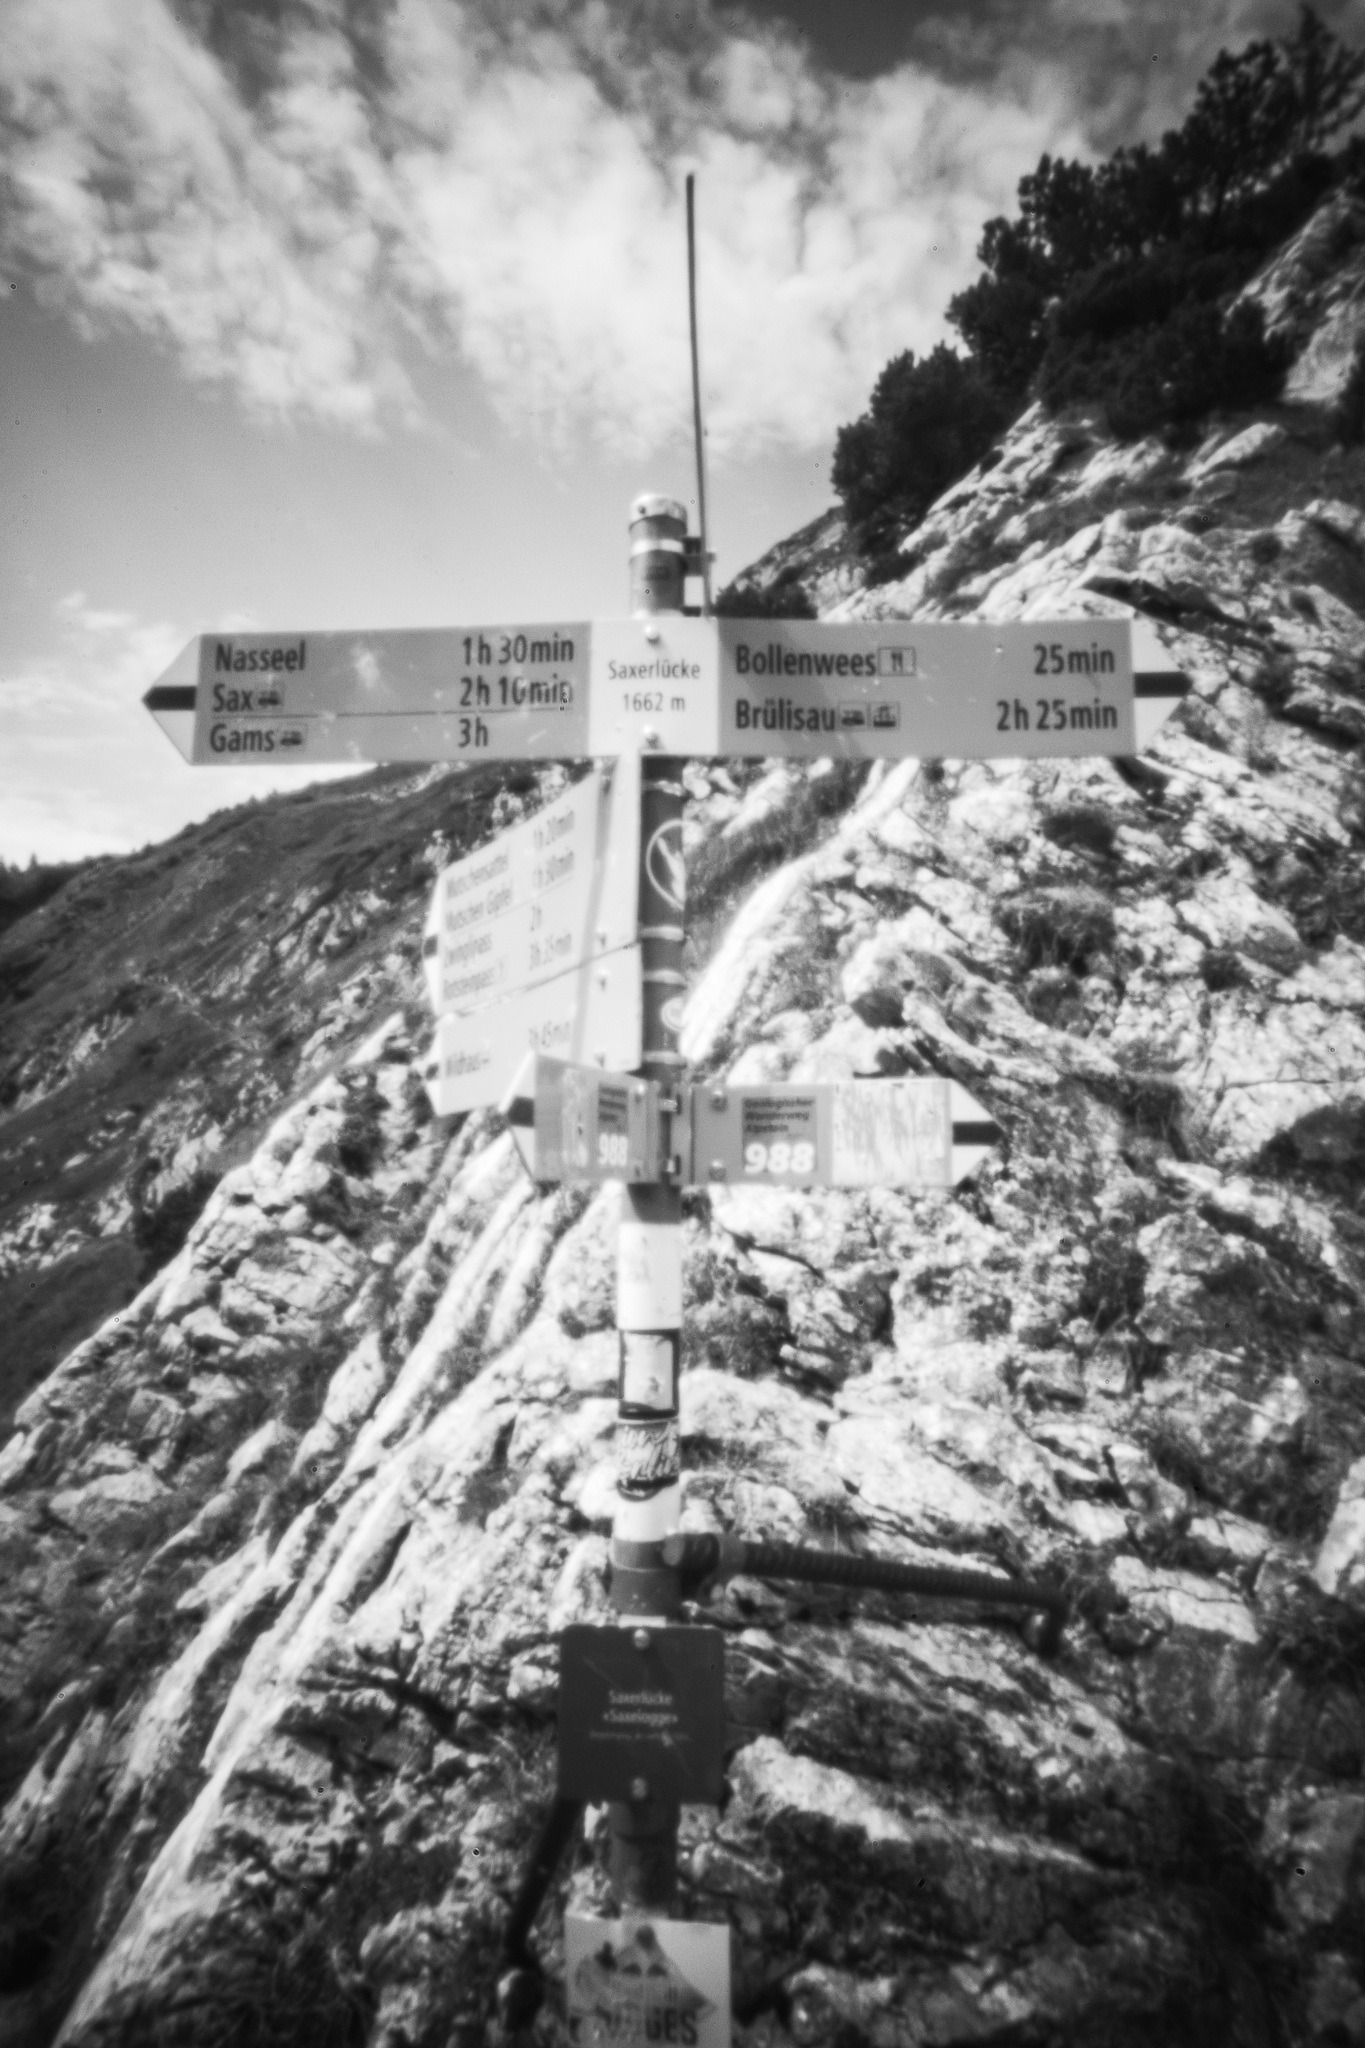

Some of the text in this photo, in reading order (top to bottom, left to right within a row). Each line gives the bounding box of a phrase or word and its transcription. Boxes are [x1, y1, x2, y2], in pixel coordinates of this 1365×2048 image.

[215, 641, 306, 673] Nasseel
[608, 660, 701, 681] Saxerlücke
[735, 643, 877, 676] Bollenwees
[212, 684, 254, 713] Sax
[623, 692, 687, 712] 1662 m
[735, 698, 837, 731] Brülisau
[209, 723, 275, 753] Gams
[743, 1141, 815, 1174] 988
